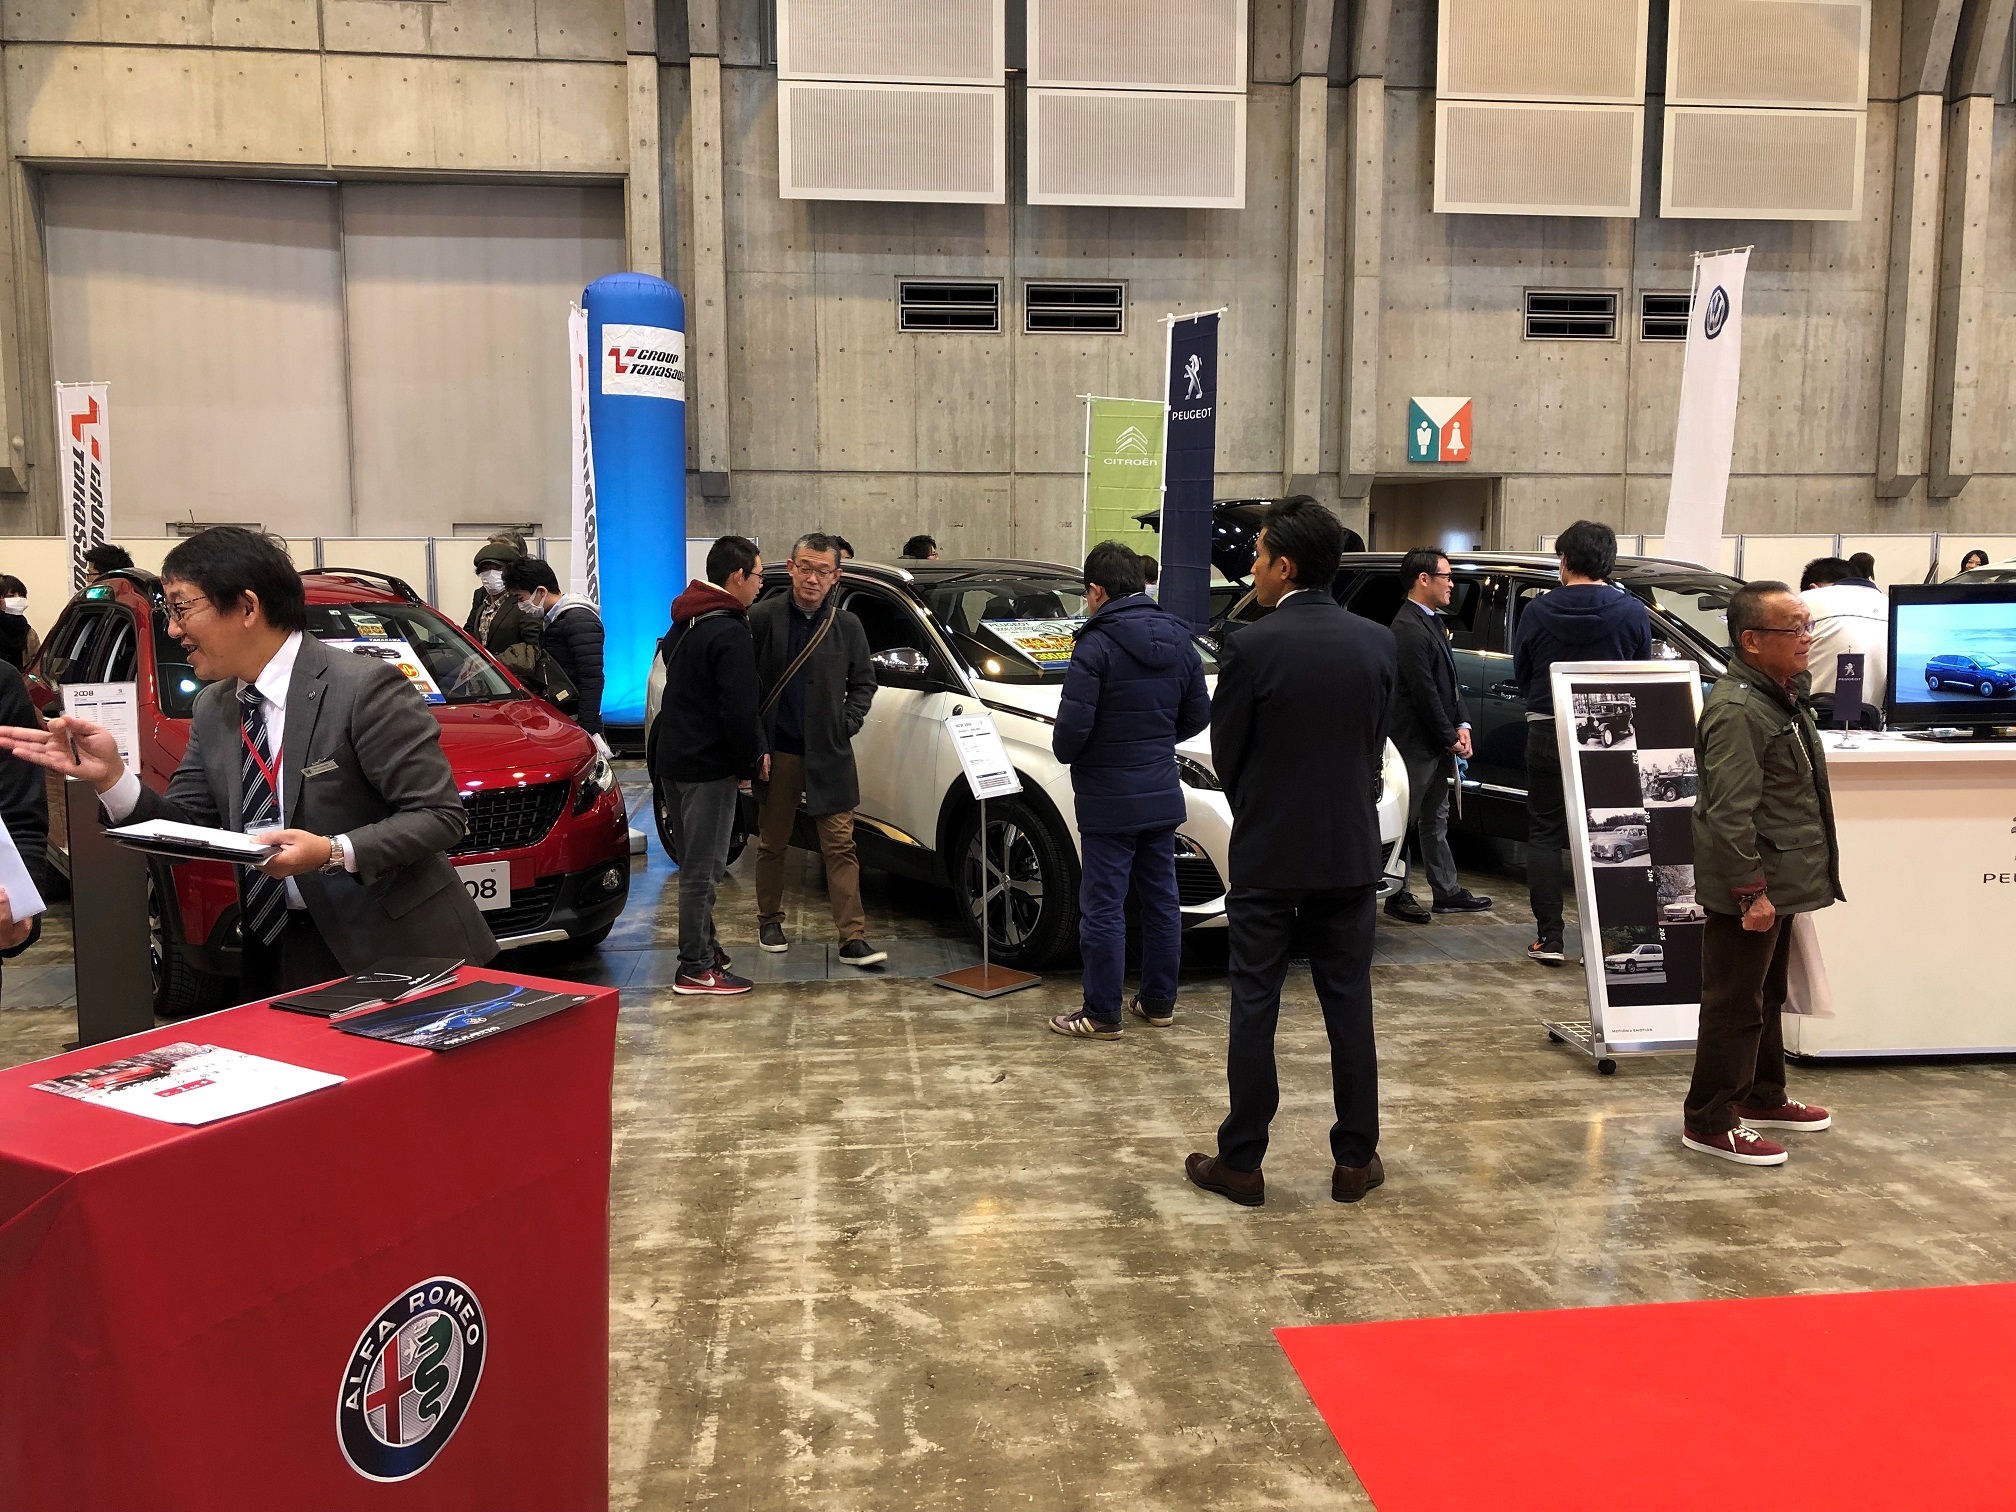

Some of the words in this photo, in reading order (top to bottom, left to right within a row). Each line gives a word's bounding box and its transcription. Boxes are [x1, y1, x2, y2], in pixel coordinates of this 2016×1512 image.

[1172, 407, 1212, 420] PEUGEOT
[89, 461, 105, 550] GROU
[1983, 873, 2016, 883] PE
[345, 1320, 397, 1410] ALFA
[408, 1286, 480, 1346] ROMEO
